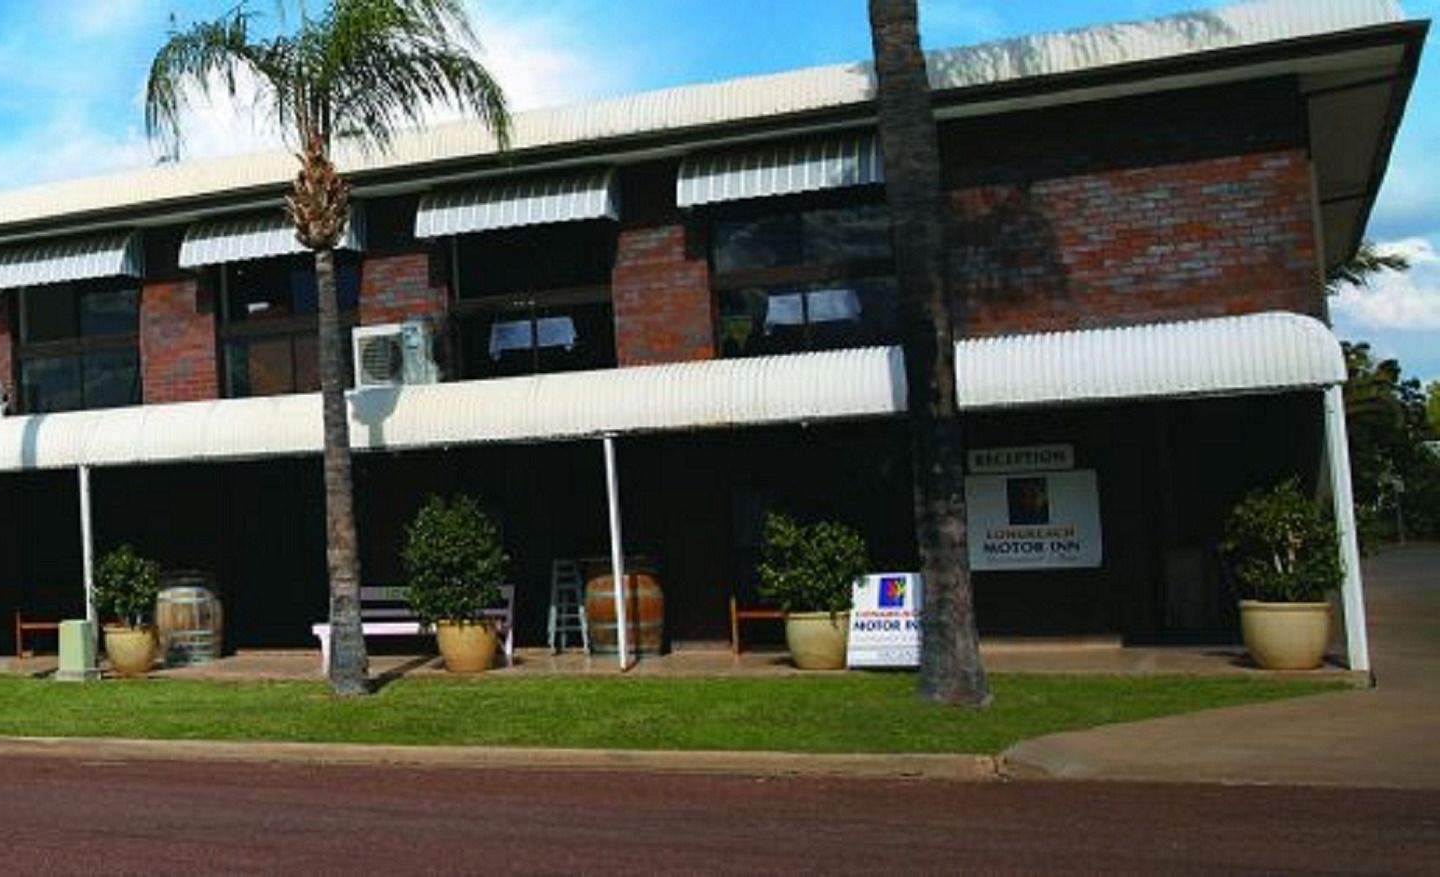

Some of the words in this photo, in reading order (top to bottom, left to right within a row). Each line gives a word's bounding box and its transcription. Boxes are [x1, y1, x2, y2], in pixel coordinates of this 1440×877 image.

[974, 449, 1067, 467] RECEPTION
[985, 526, 1076, 540] LONGREACH
[983, 541, 1044, 555] MOTOR
[1050, 540, 1081, 553] INN
[853, 619, 901, 632] MOTOR
